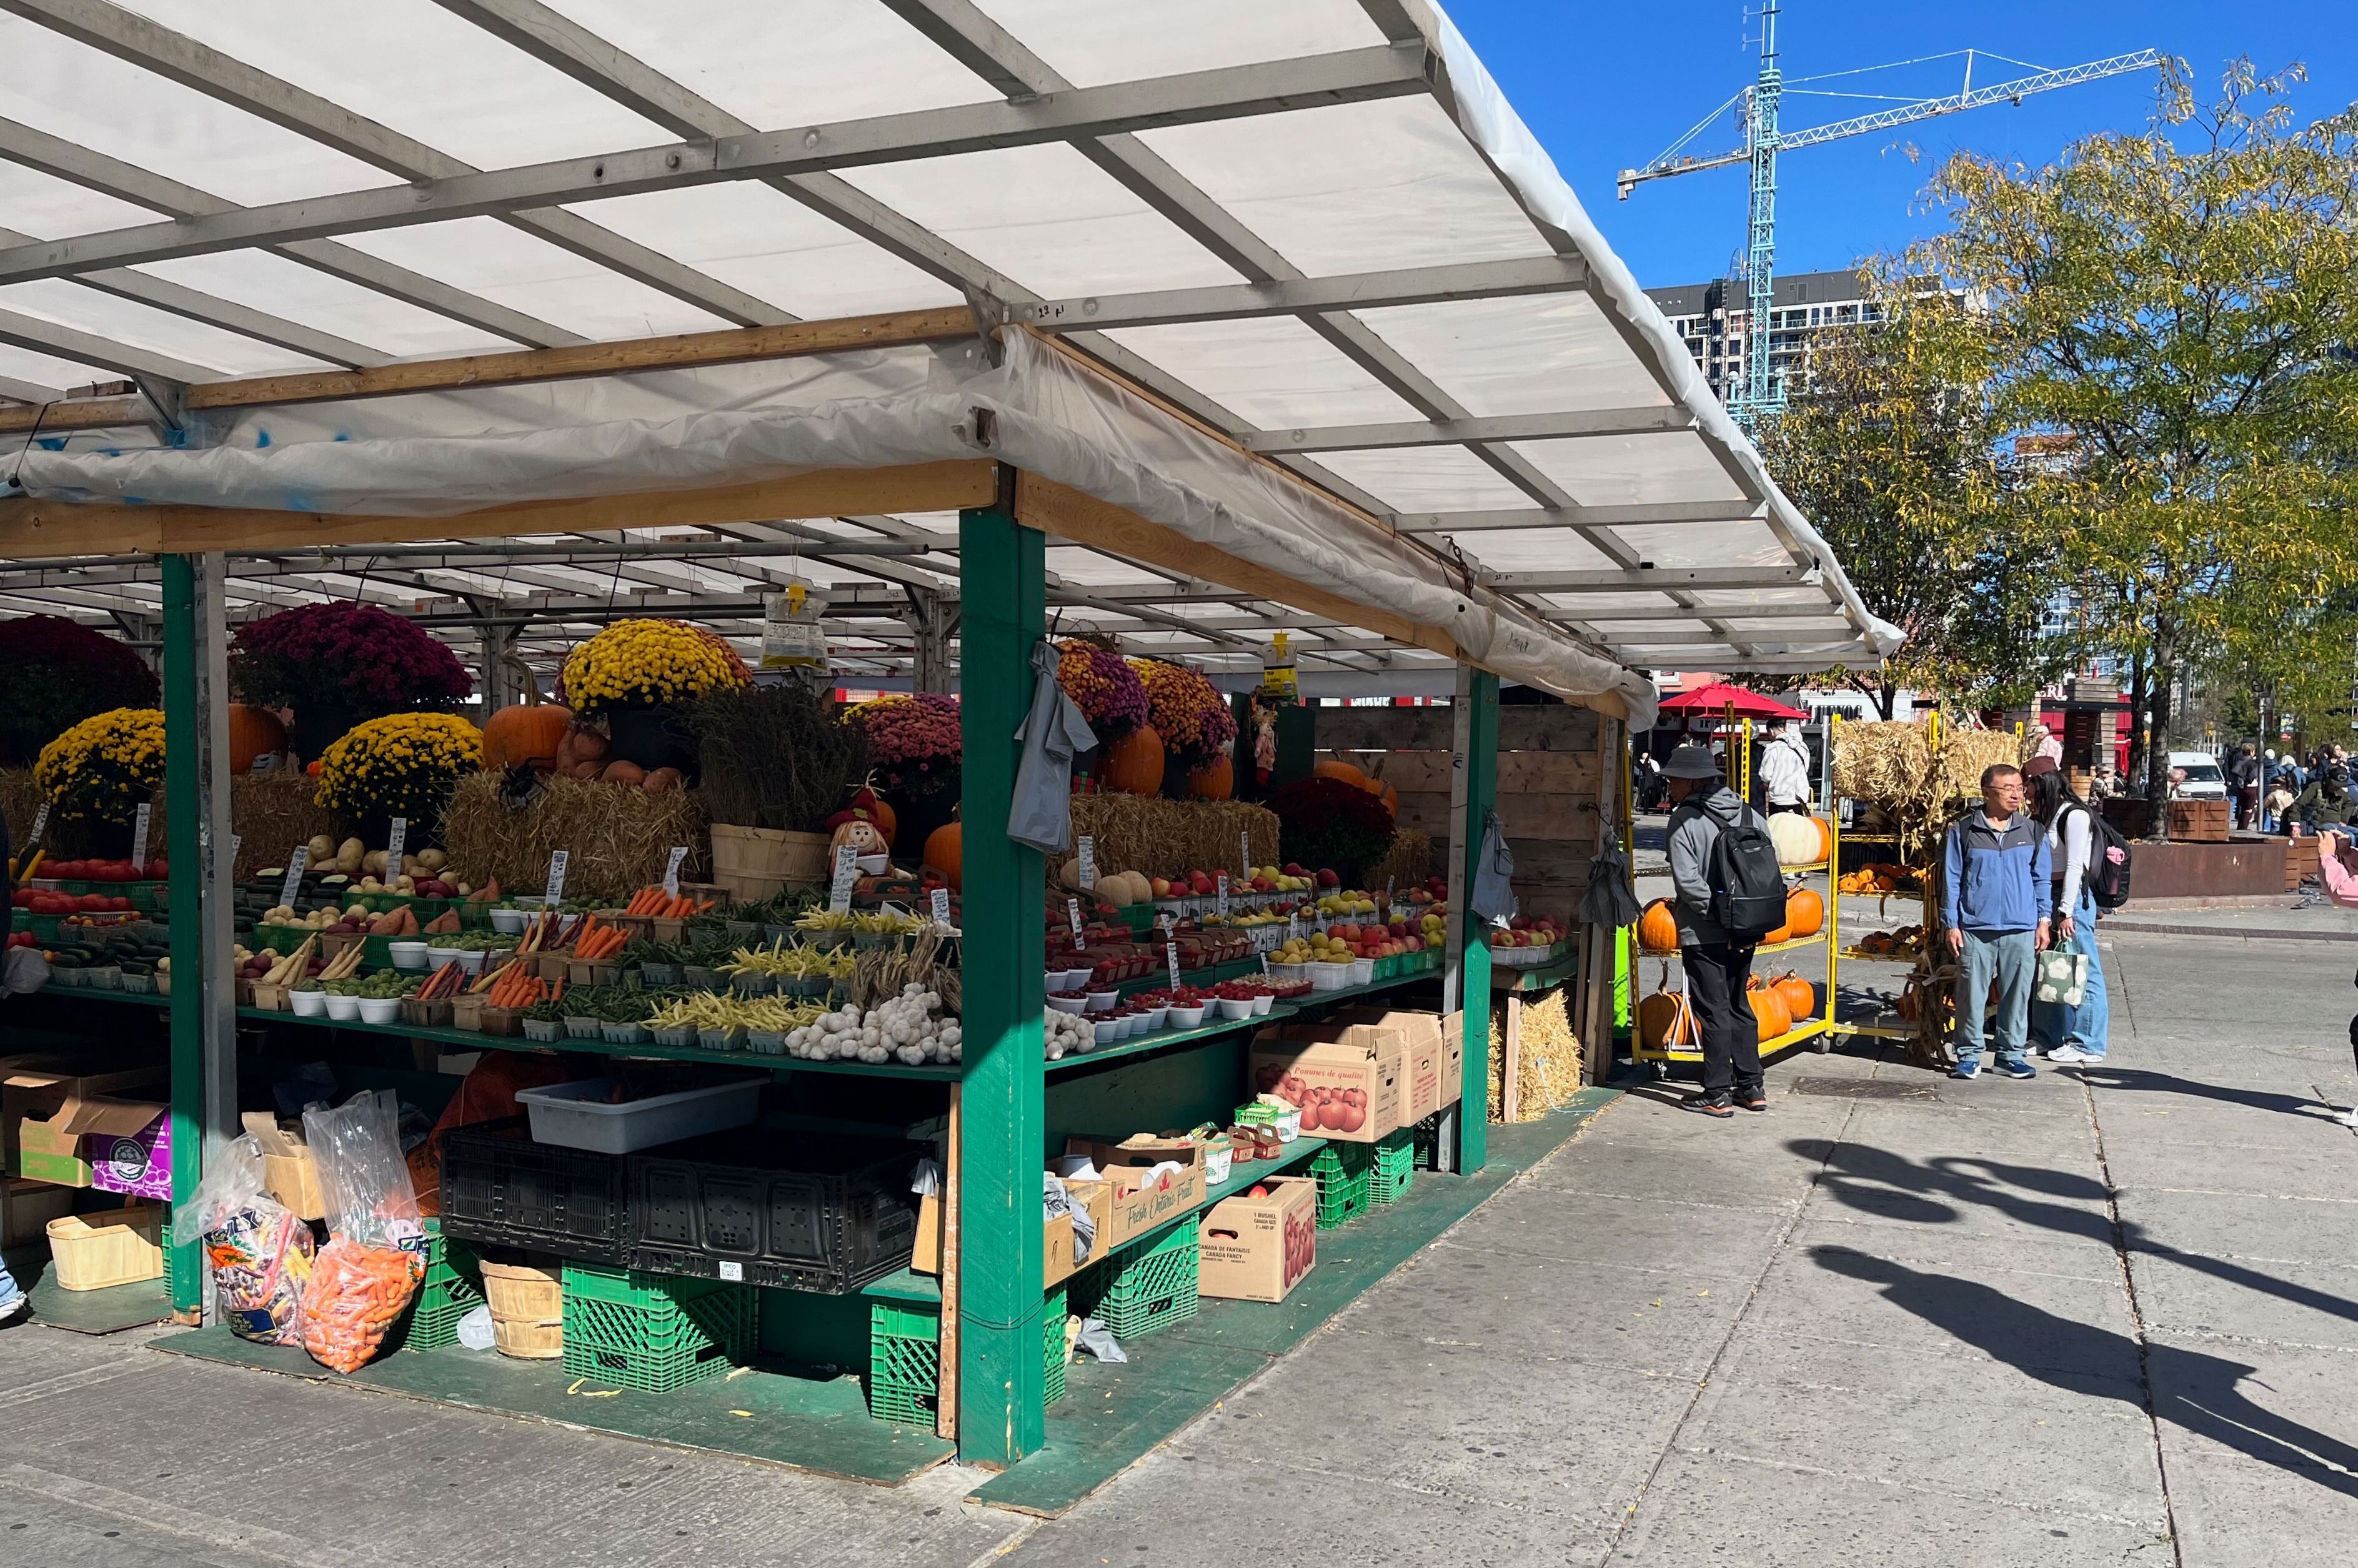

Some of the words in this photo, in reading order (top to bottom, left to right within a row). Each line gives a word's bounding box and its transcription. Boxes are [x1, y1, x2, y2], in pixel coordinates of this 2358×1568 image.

[1294, 1067, 1325, 1076] Pommes
[1327, 1069, 1335, 1078] de
[1338, 1071, 1363, 1080] qualité
[1127, 1203, 1148, 1229] Fresh
[1177, 1176, 1195, 1206] Fruit
